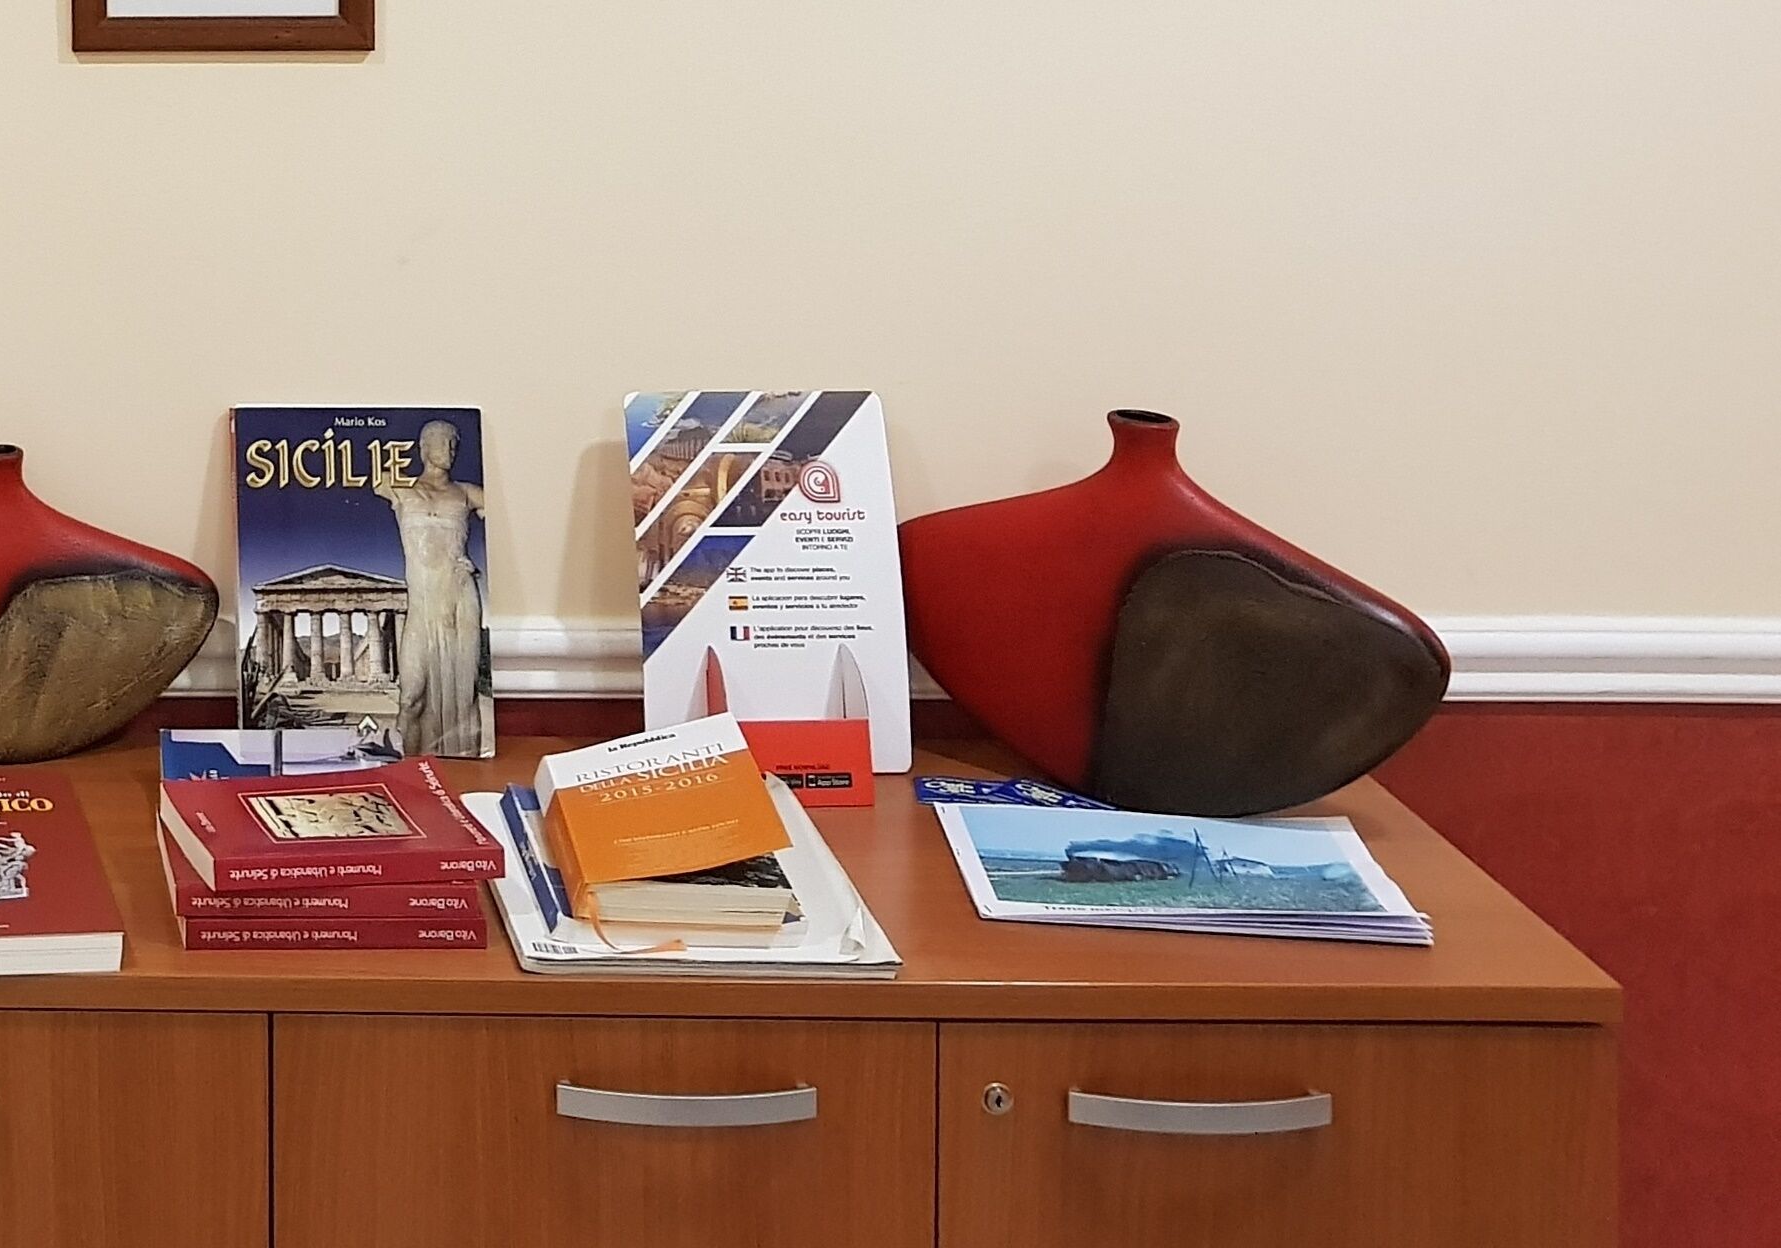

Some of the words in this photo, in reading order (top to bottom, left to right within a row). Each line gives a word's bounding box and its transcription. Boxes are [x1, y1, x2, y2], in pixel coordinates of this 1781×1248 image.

[334, 417, 365, 427] Mario
[367, 416, 386, 427] Kos
[246, 428, 418, 488] SICÍLIE
[780, 512, 812, 524] easy
[817, 508, 866, 521] tourist
[576, 742, 724, 783] RISTORANTI
[637, 754, 730, 781] SICILIA
[335, 864, 382, 877] Monumenti
[440, 860, 475, 872] Barone
[475, 860, 497, 871] Vito
[280, 866, 327, 879] Urbanistica
[409, 897, 446, 908] Barone
[446, 898, 468, 909] Vito
[418, 930, 455, 941] Barone
[454, 930, 477, 941] Vito
